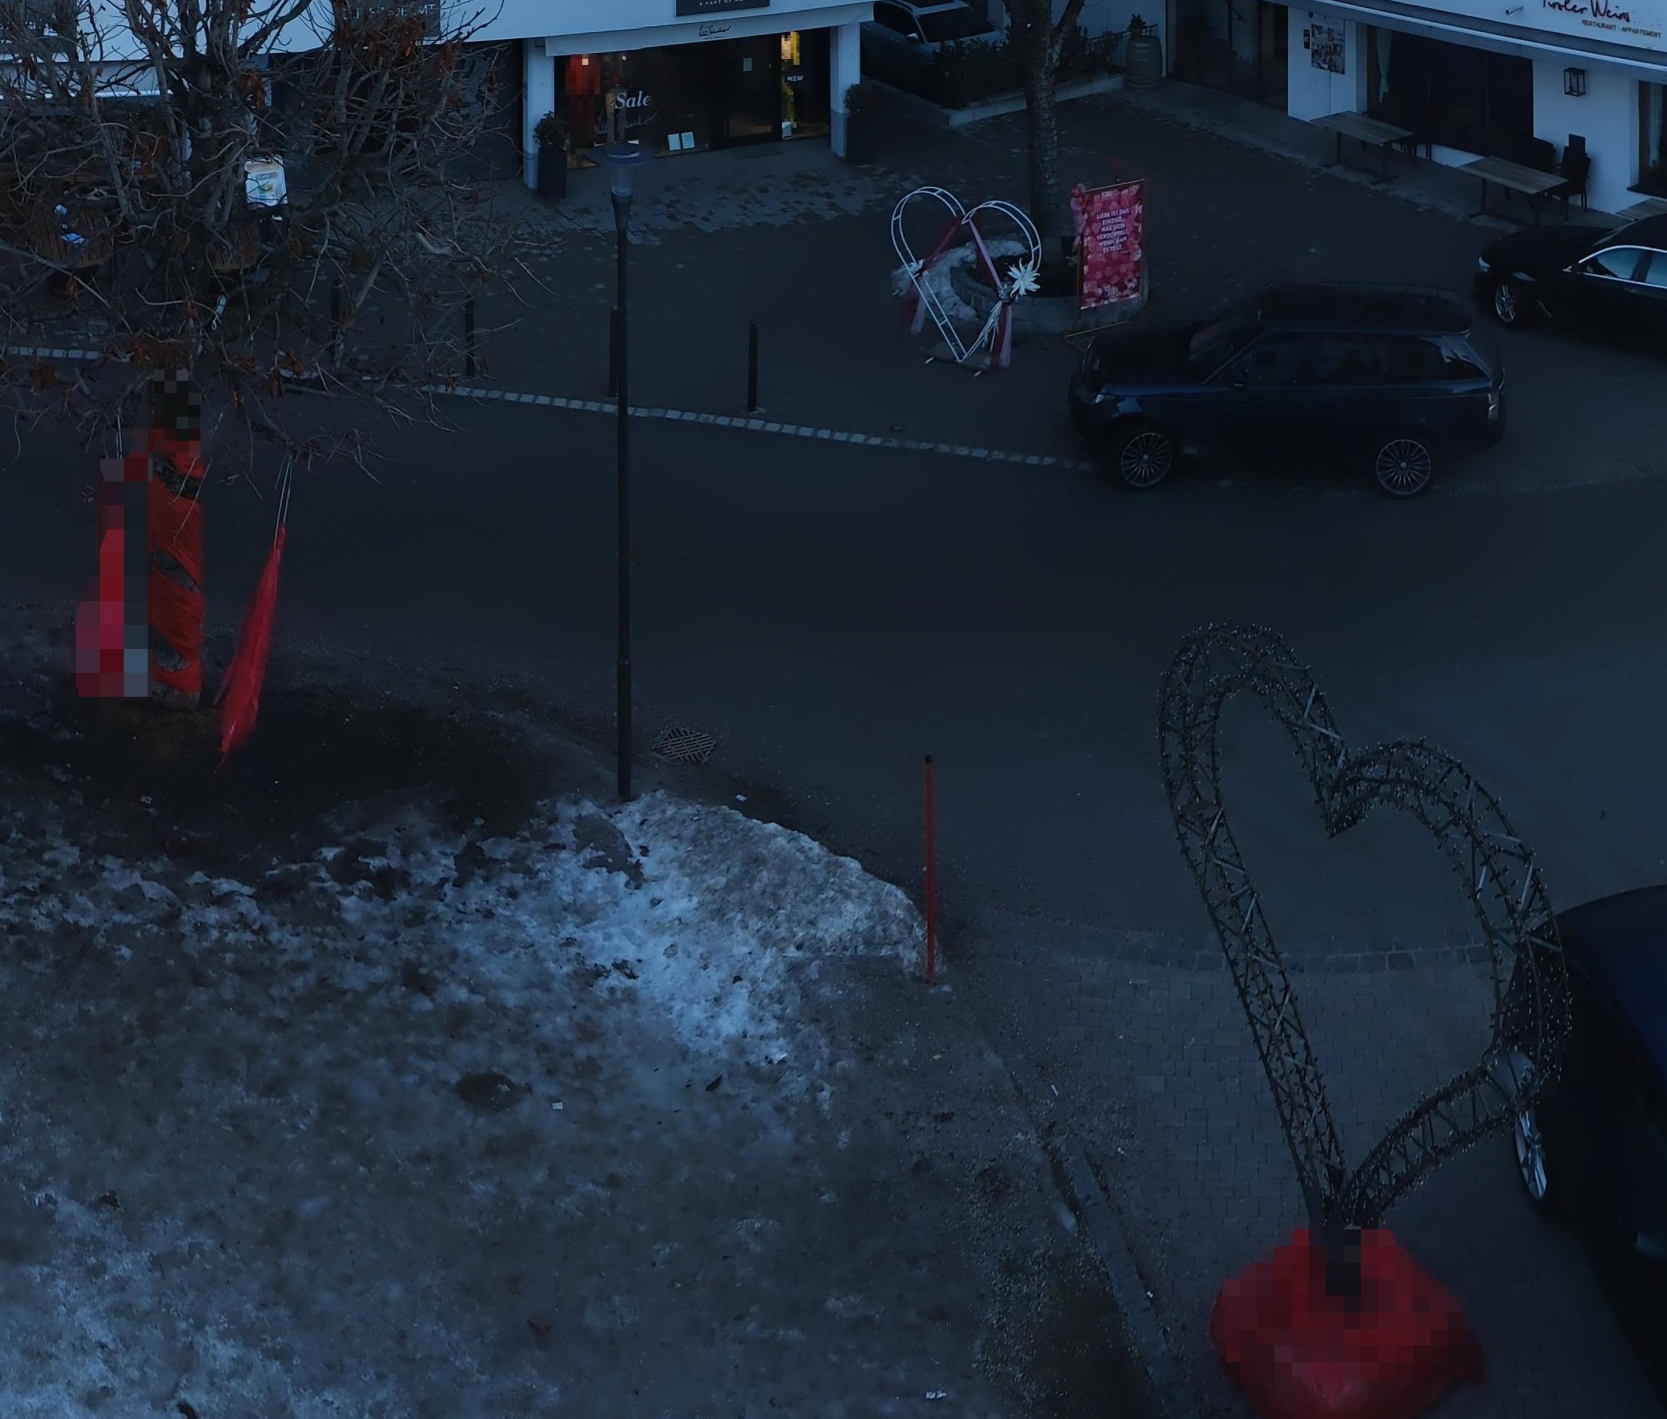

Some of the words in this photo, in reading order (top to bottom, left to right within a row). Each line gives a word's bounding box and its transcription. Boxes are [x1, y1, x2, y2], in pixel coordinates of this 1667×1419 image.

[1582, 19, 1617, 31] RESTAURANT
[1621, 26, 1662, 38] APPARTEMENT
[614, 90, 652, 110] Sale
